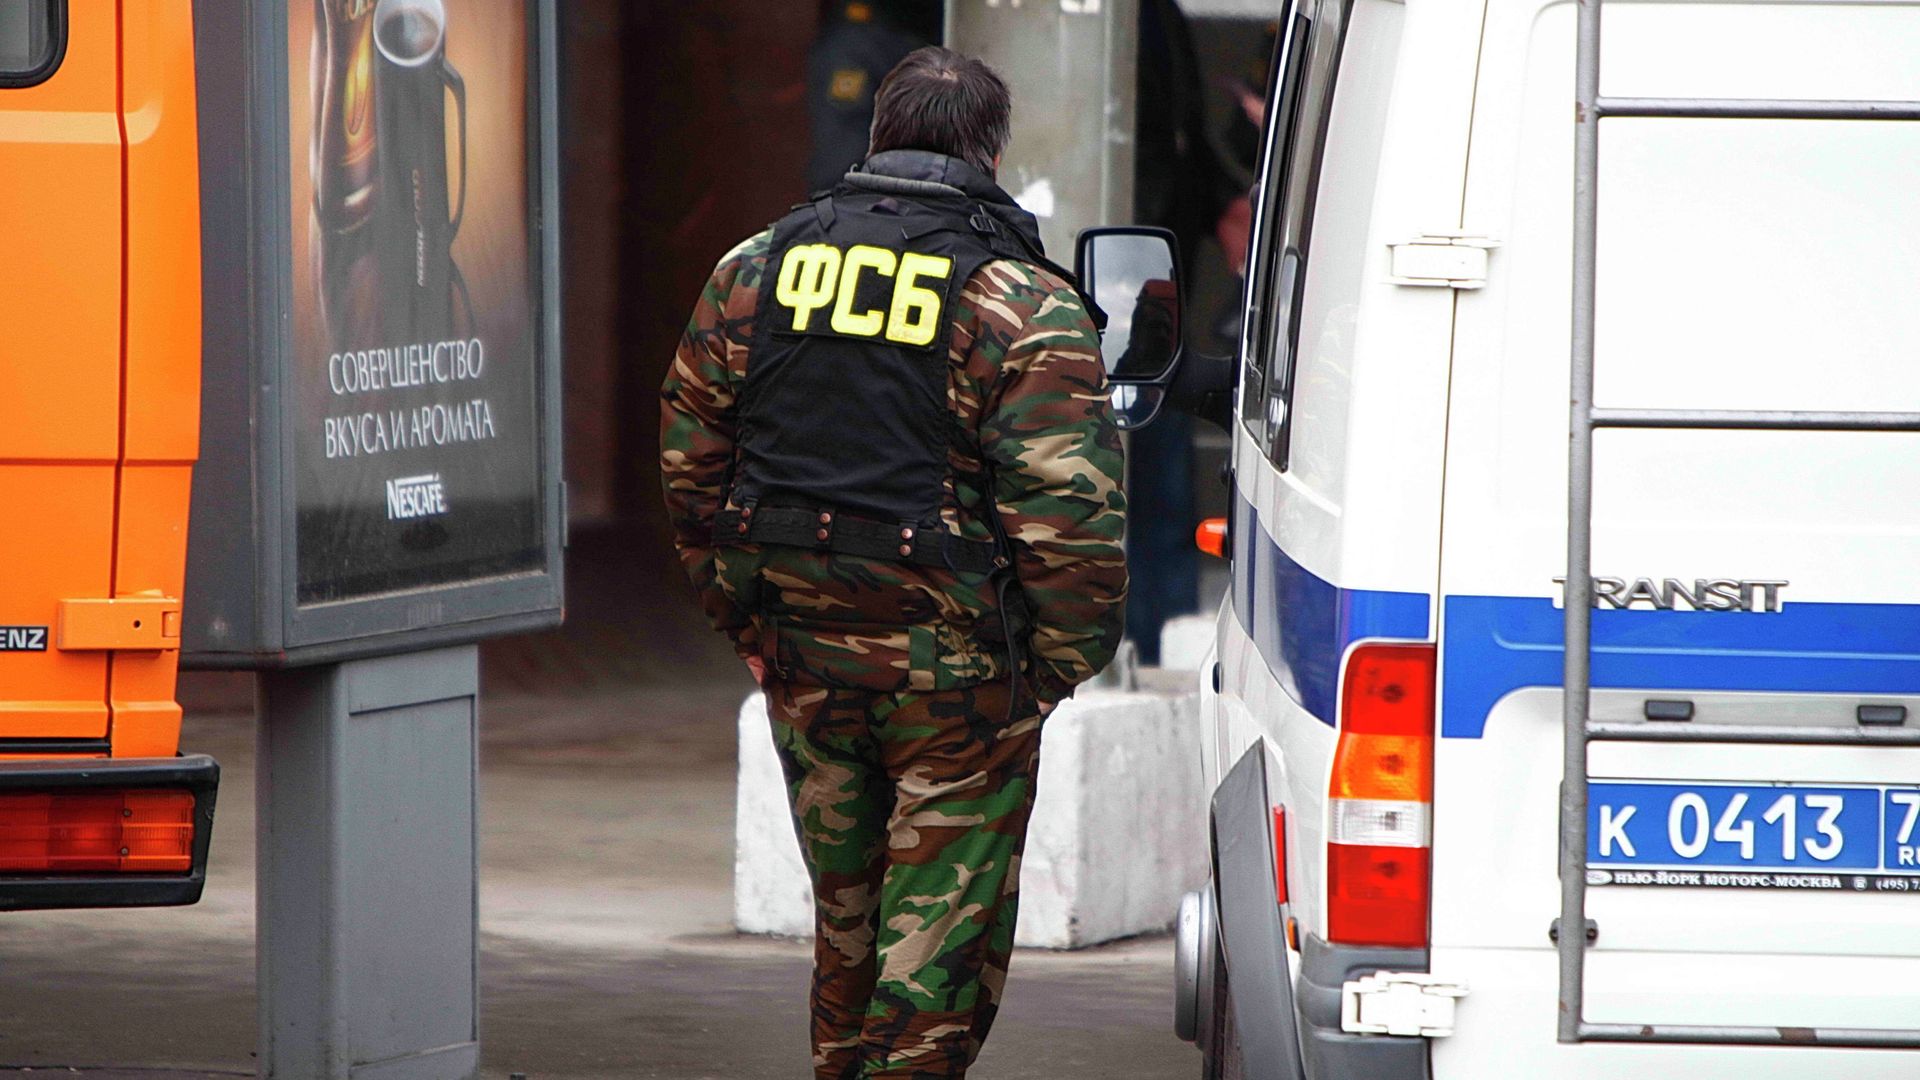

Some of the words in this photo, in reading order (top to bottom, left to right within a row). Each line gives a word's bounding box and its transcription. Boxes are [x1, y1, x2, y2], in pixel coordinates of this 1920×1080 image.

[776, 243, 951, 345] ФСБ
[329, 338, 483, 395] СОВЕРШЕНСТВО
[324, 412, 389, 458] ВКУСА
[390, 410, 406, 449] И
[410, 400, 496, 447] АРОМАТА
[1668, 792, 1844, 861] 0413
[1614, 871, 1702, 885] НЬЮ-ЙОРК
[1703, 873, 1842, 888] МОТОРС-МОСКВА
